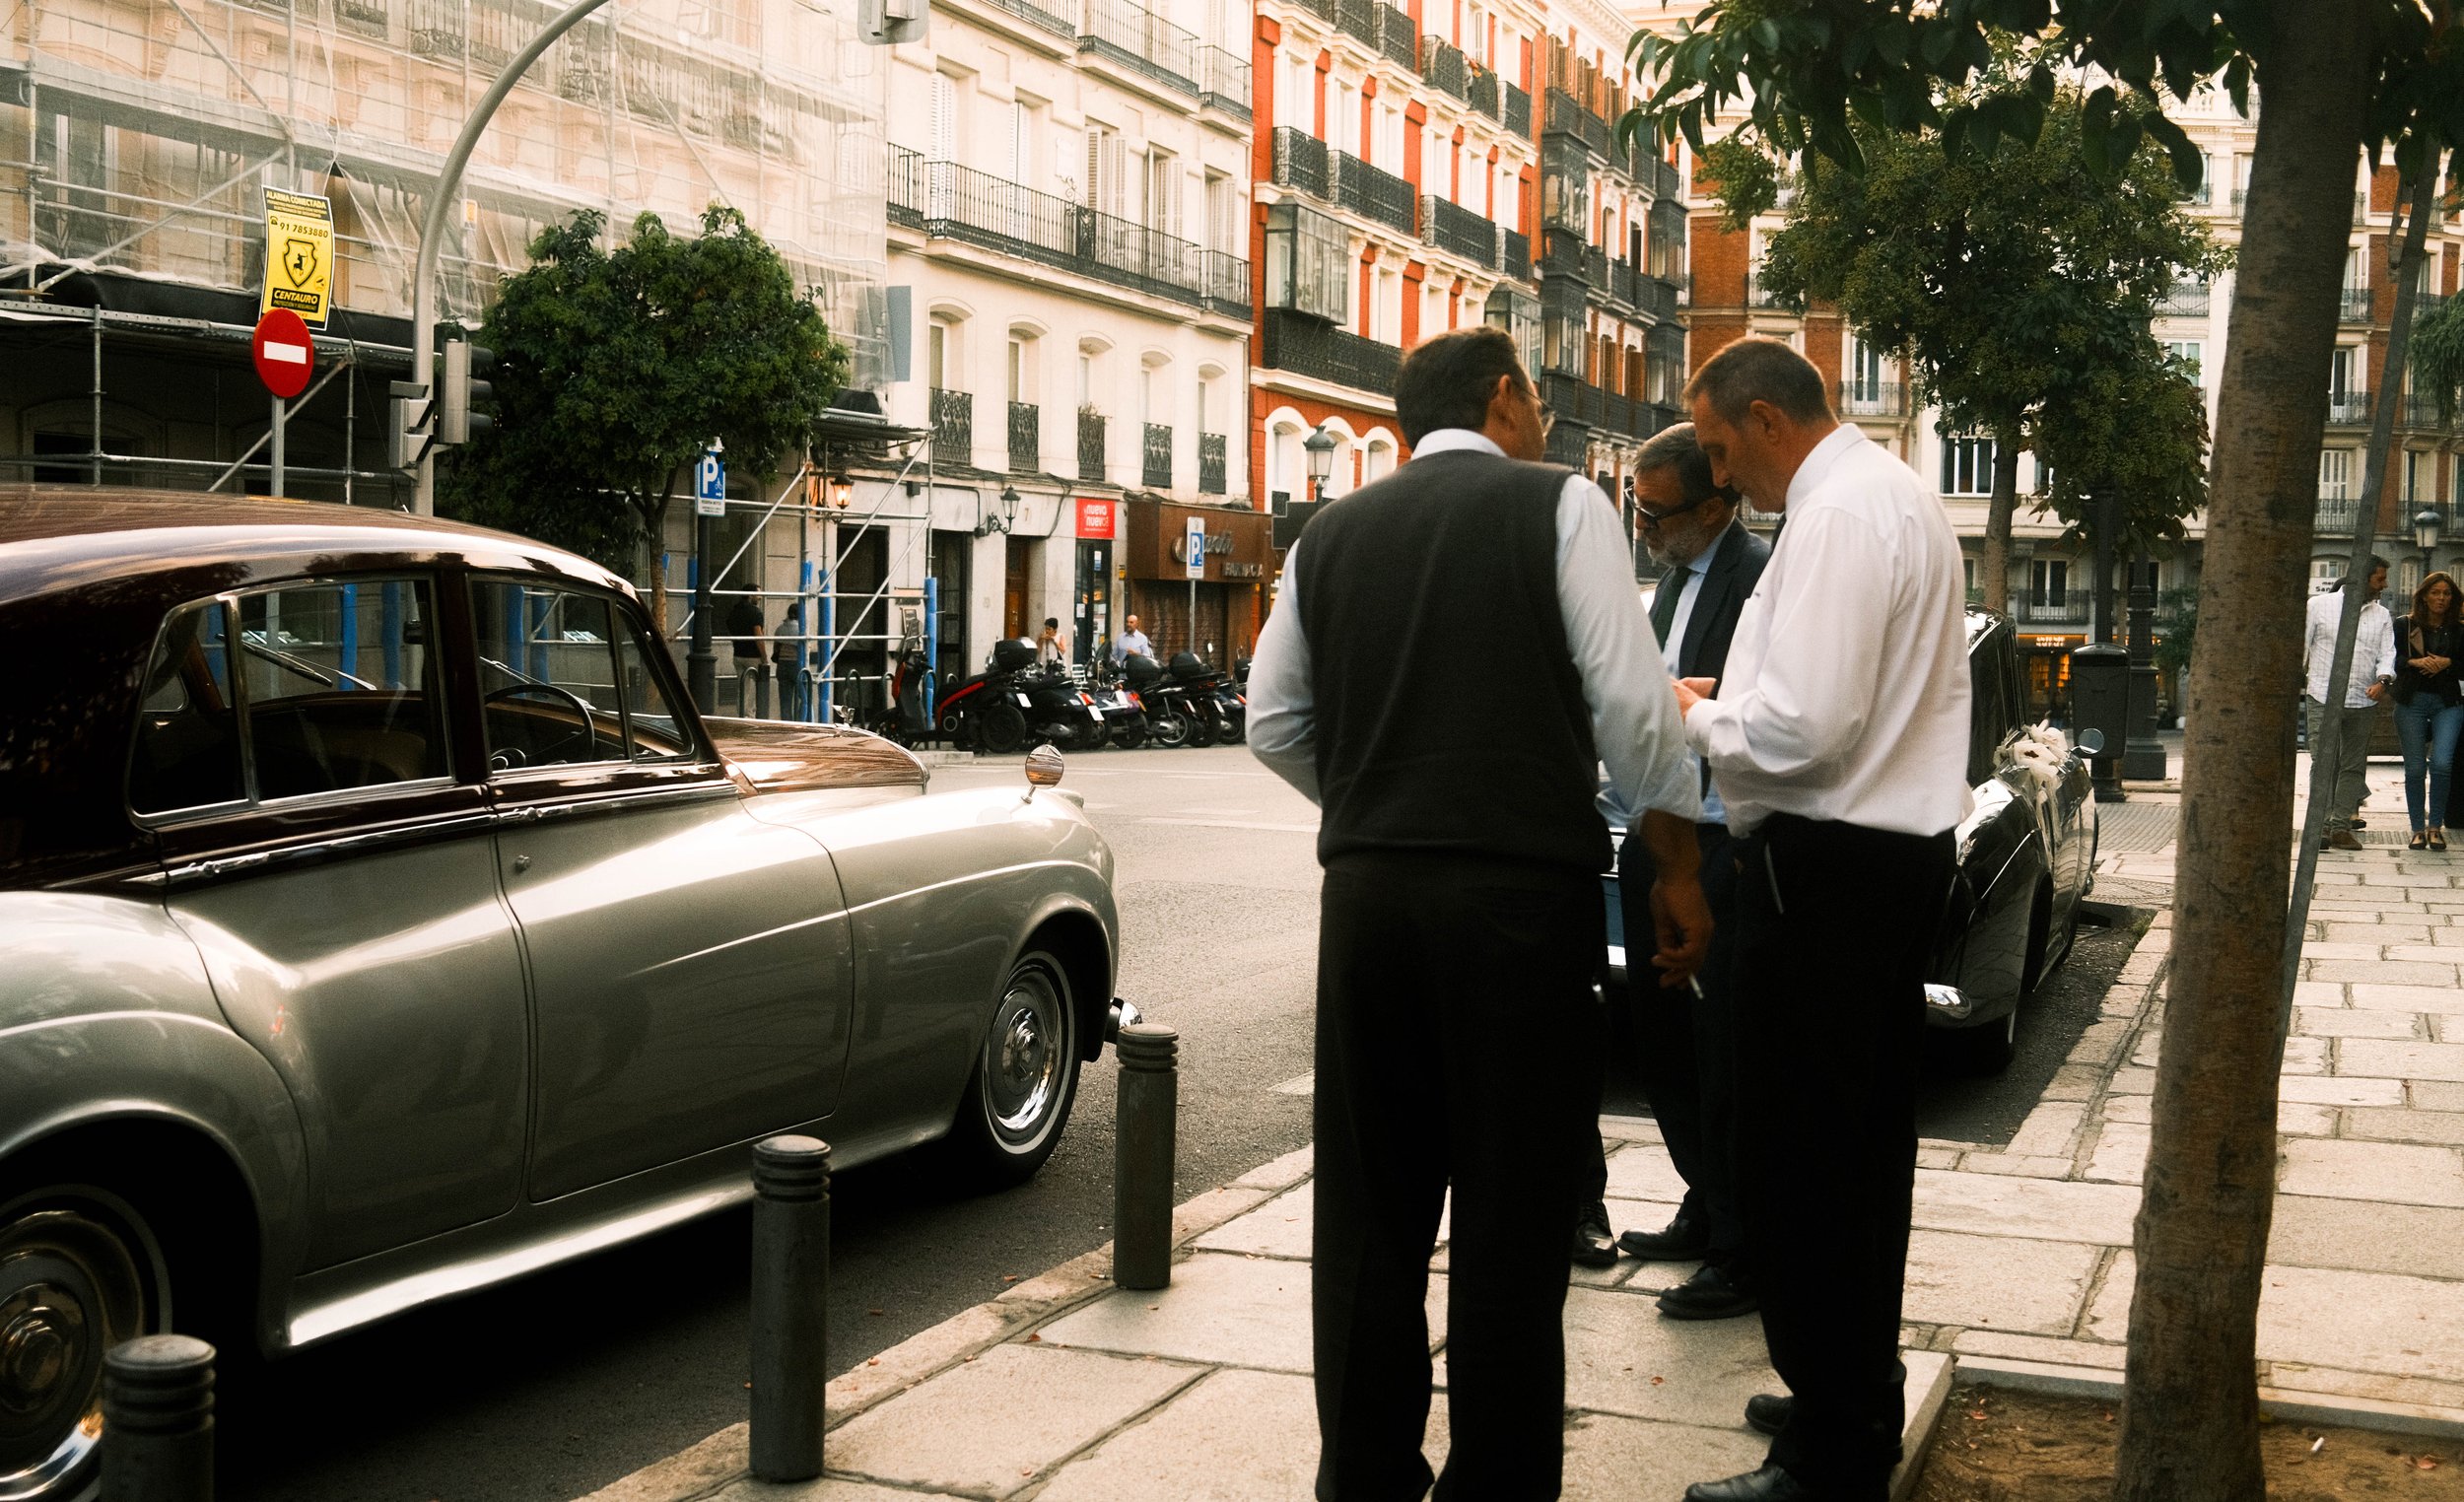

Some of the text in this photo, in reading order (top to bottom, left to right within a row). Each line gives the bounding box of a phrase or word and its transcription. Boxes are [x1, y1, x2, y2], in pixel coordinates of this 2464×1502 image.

[280, 222, 329, 238] 91 7853880
[274, 290, 318, 305] CENTAURO
[702, 455, 719, 494] P
[1191, 535, 1200, 564] P
